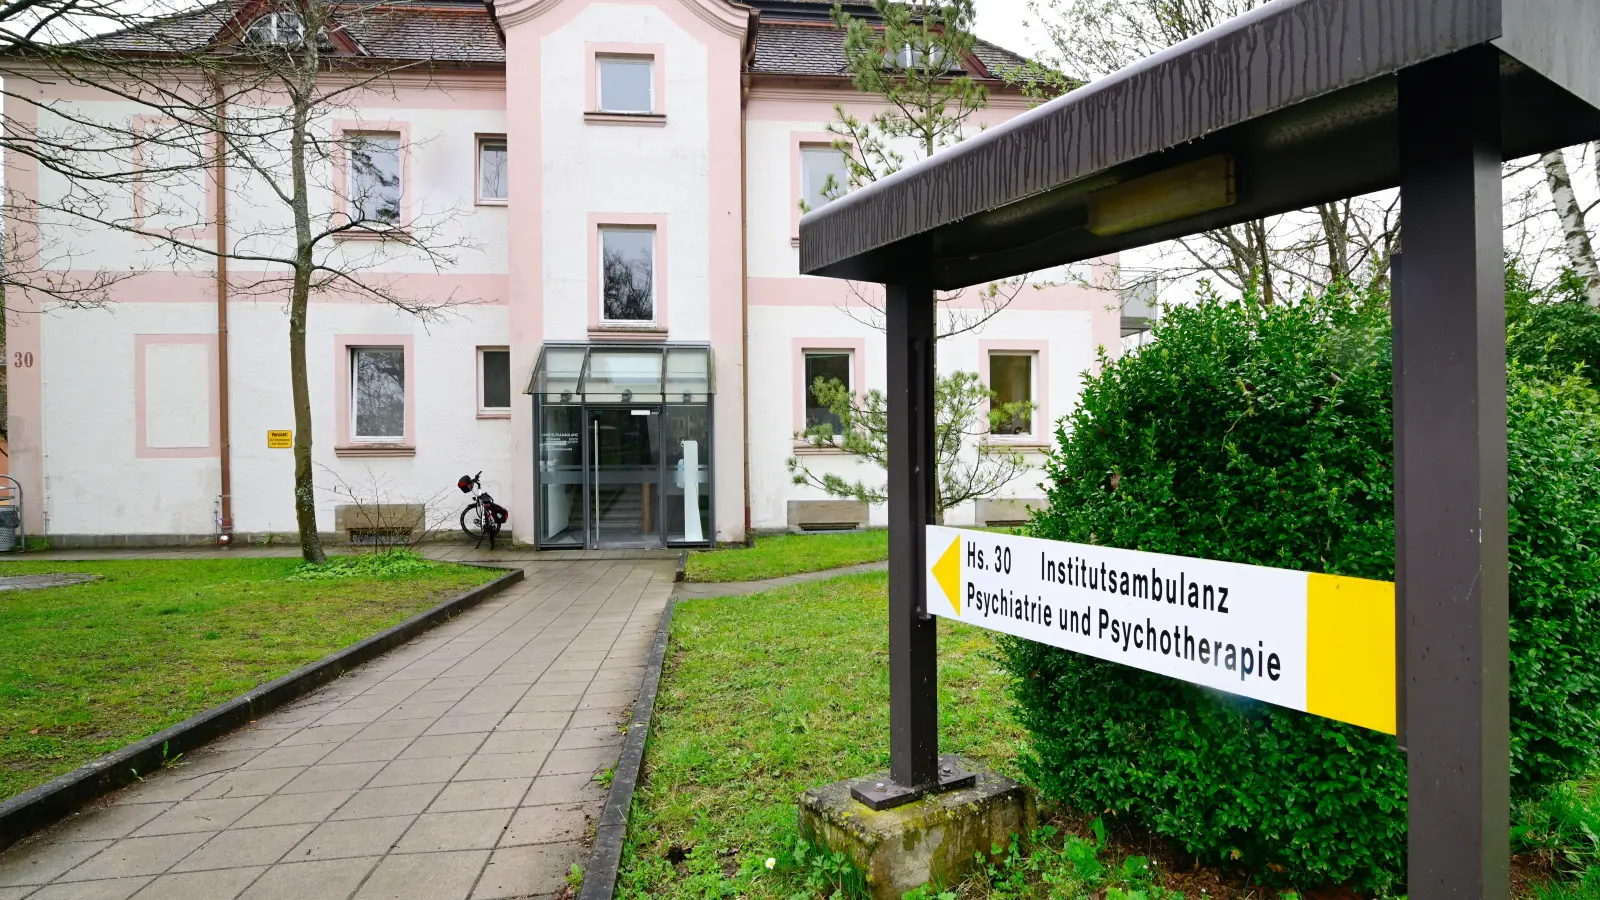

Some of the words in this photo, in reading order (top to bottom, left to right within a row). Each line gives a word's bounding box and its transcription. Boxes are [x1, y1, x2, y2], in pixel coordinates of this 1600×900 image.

[14, 352, 34, 368] 30
[967, 540, 989, 571] Hs.
[994, 545, 1012, 575] 30
[1041, 551, 1229, 614] Institutsambulanz
[967, 581, 1052, 627] Psychiatrie
[1059, 605, 1091, 637] und
[1098, 608, 1281, 682] Psychotherapie
